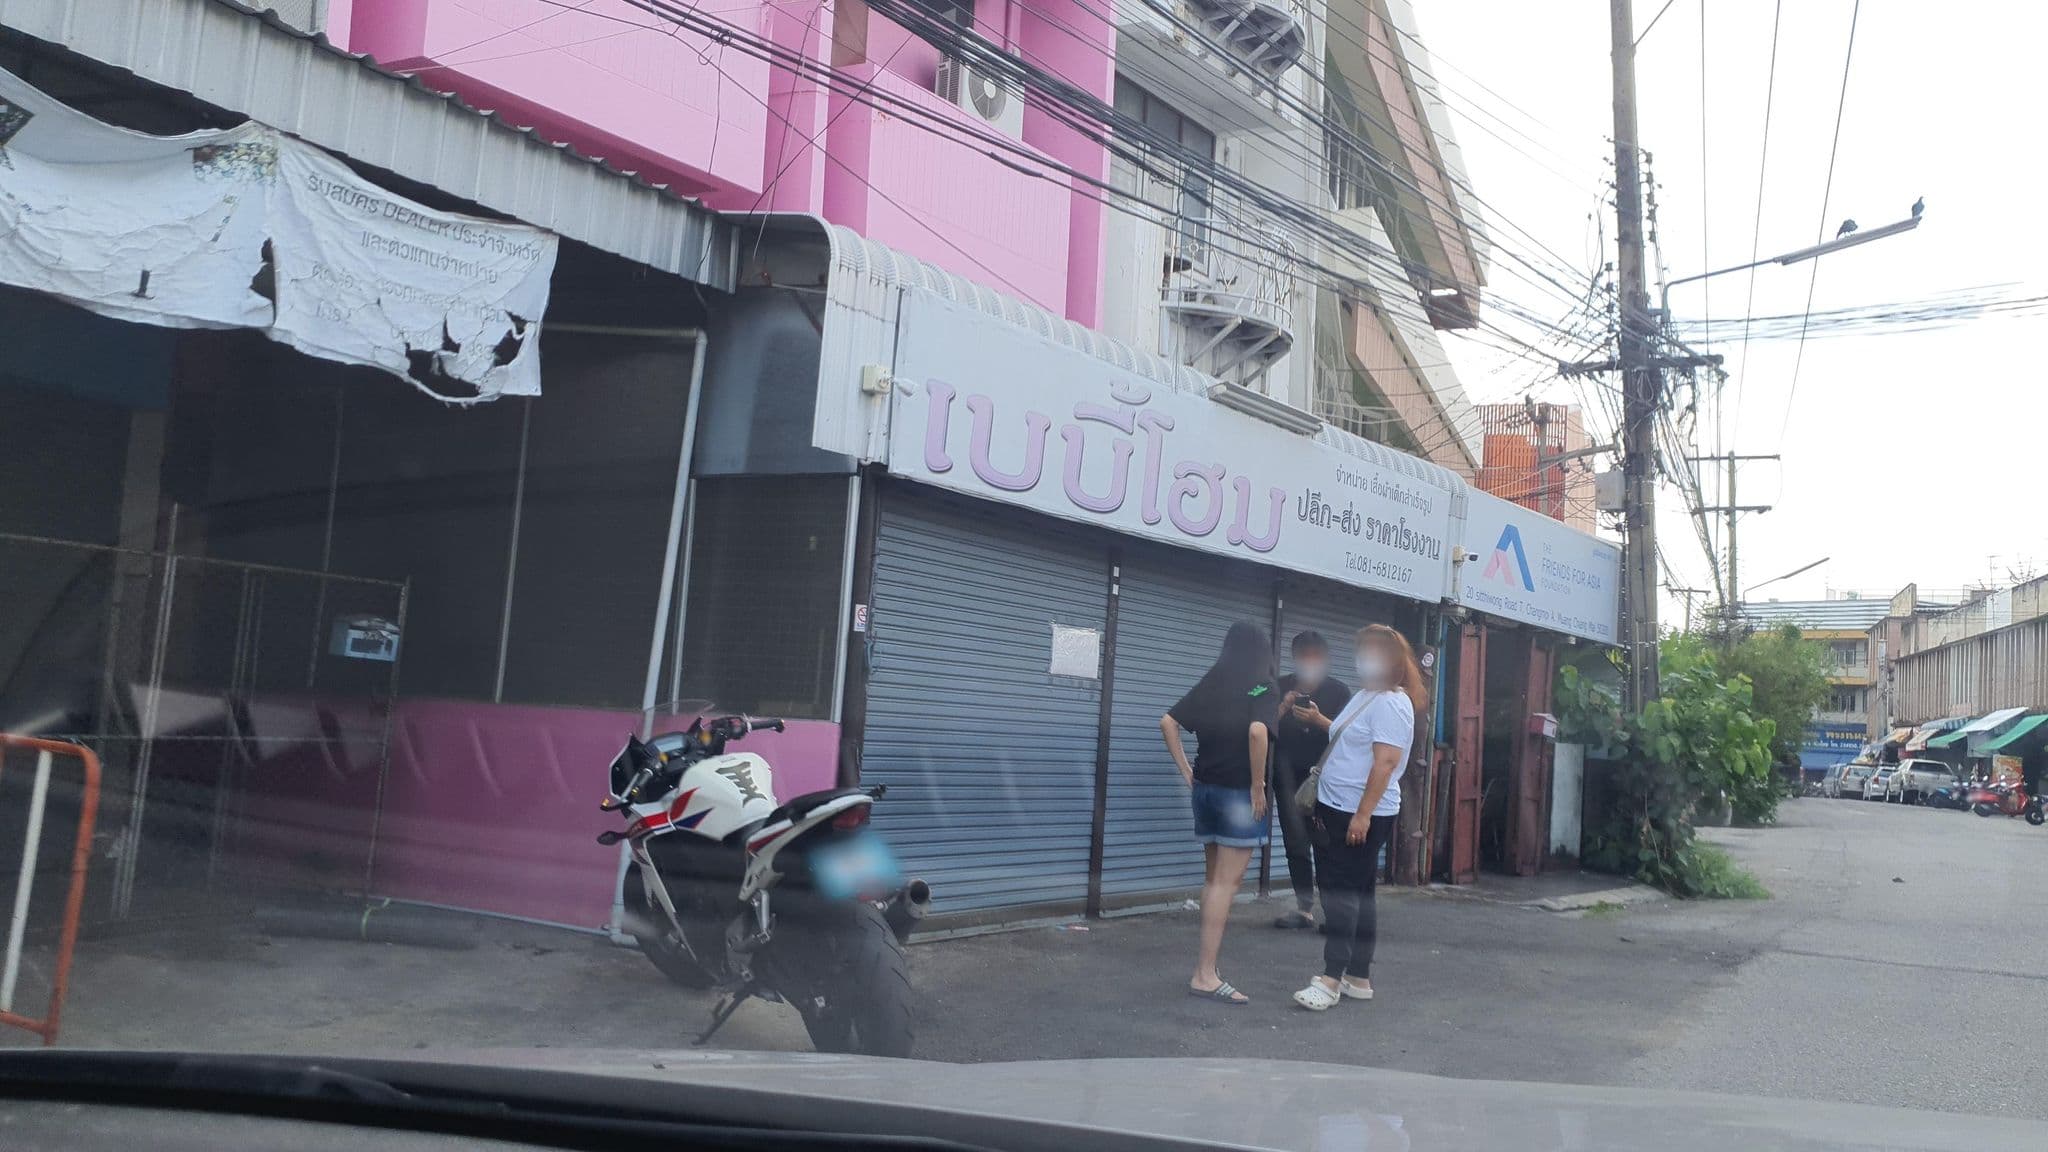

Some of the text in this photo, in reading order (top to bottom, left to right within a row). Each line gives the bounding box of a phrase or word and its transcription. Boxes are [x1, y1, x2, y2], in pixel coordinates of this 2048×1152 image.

[383, 201, 449, 239] DEALER
[924, 379, 1286, 552] เบบี้โฮม
[1336, 464, 1368, 491] จำหน่าย
[1366, 517, 1441, 561] ราคาโรงงาน
[1542, 558, 1601, 590] FRIENDS FOR ASIA
